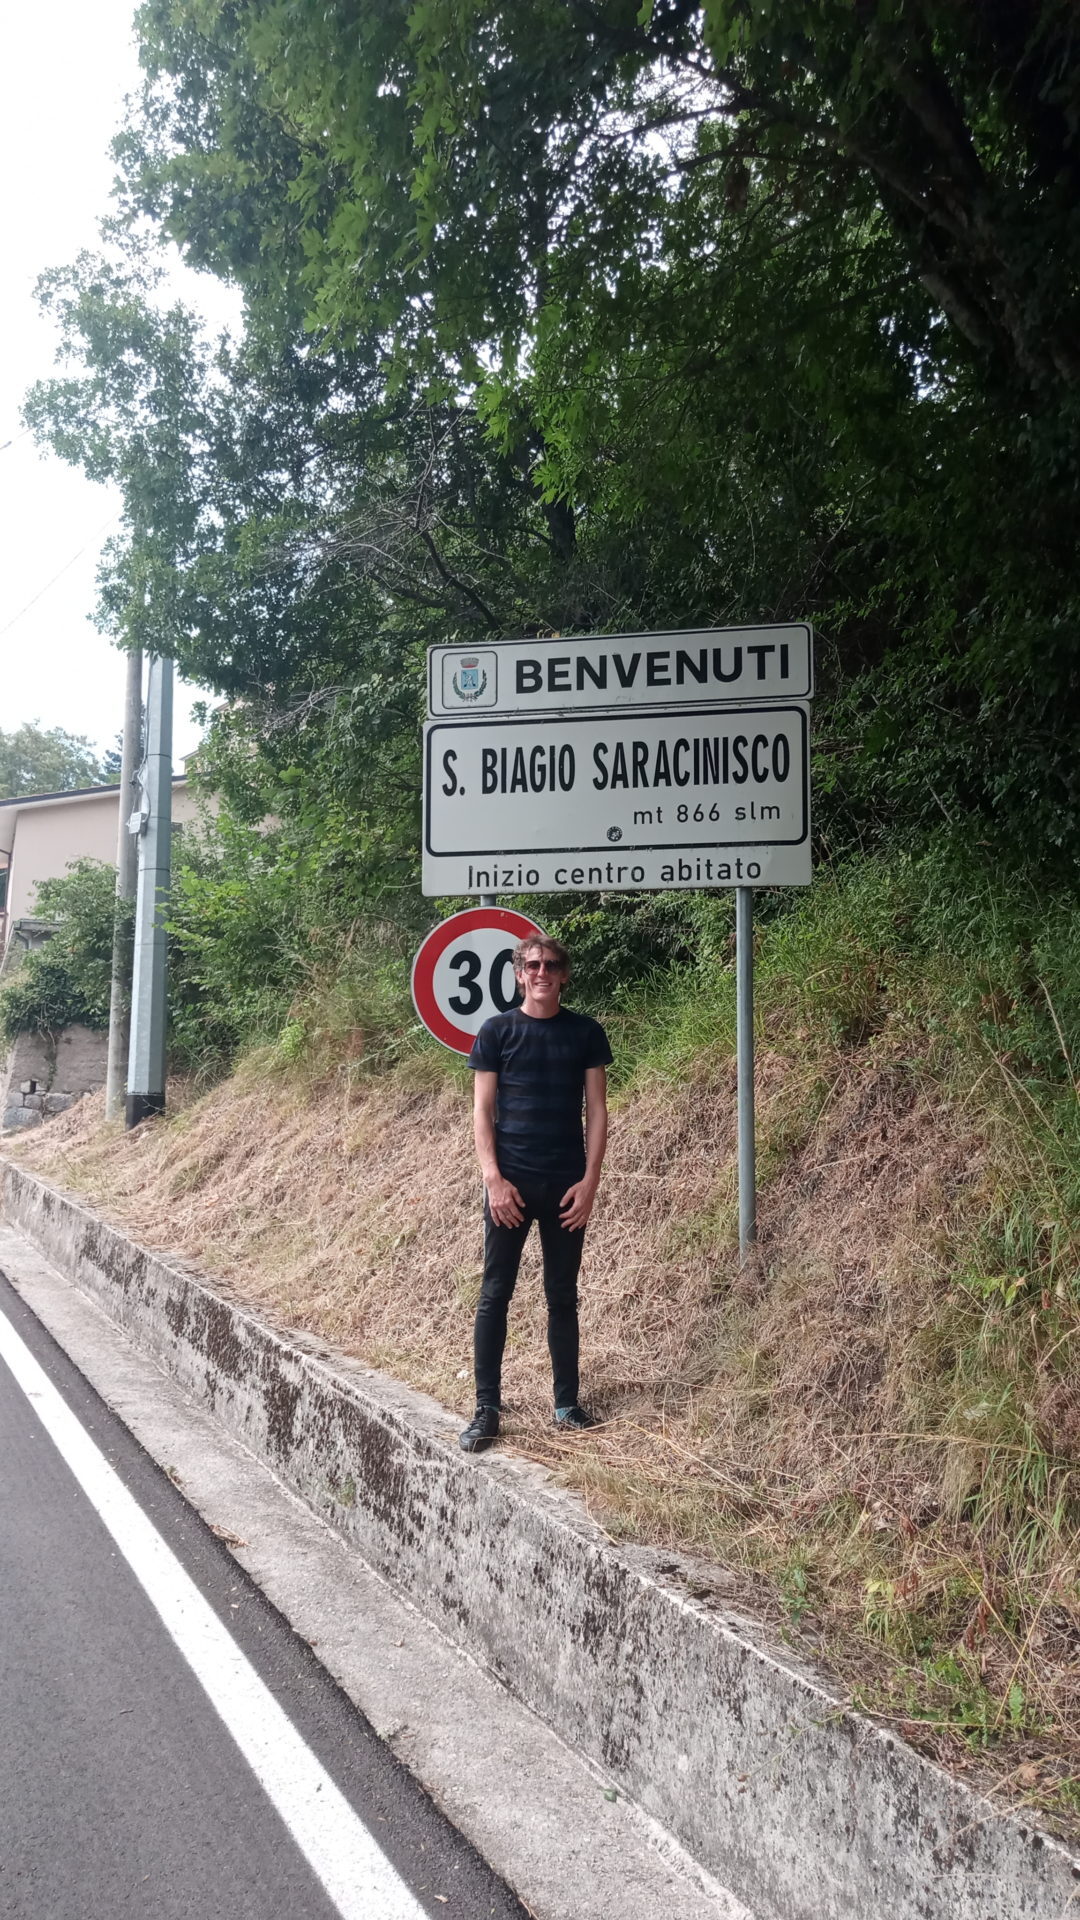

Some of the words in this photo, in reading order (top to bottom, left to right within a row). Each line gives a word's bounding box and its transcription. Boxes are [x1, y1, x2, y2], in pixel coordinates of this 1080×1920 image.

[515, 643, 789, 694] BENVENUTI
[441, 749, 466, 797] S.
[481, 743, 576, 795] BIAGIO
[592, 733, 790, 790] SARACINISCO
[633, 805, 663, 825] mt
[676, 803, 720, 823] 866
[734, 801, 781, 821] slm
[468, 863, 540, 889] Inizio
[554, 862, 645, 885] centro
[660, 857, 762, 882] abitato
